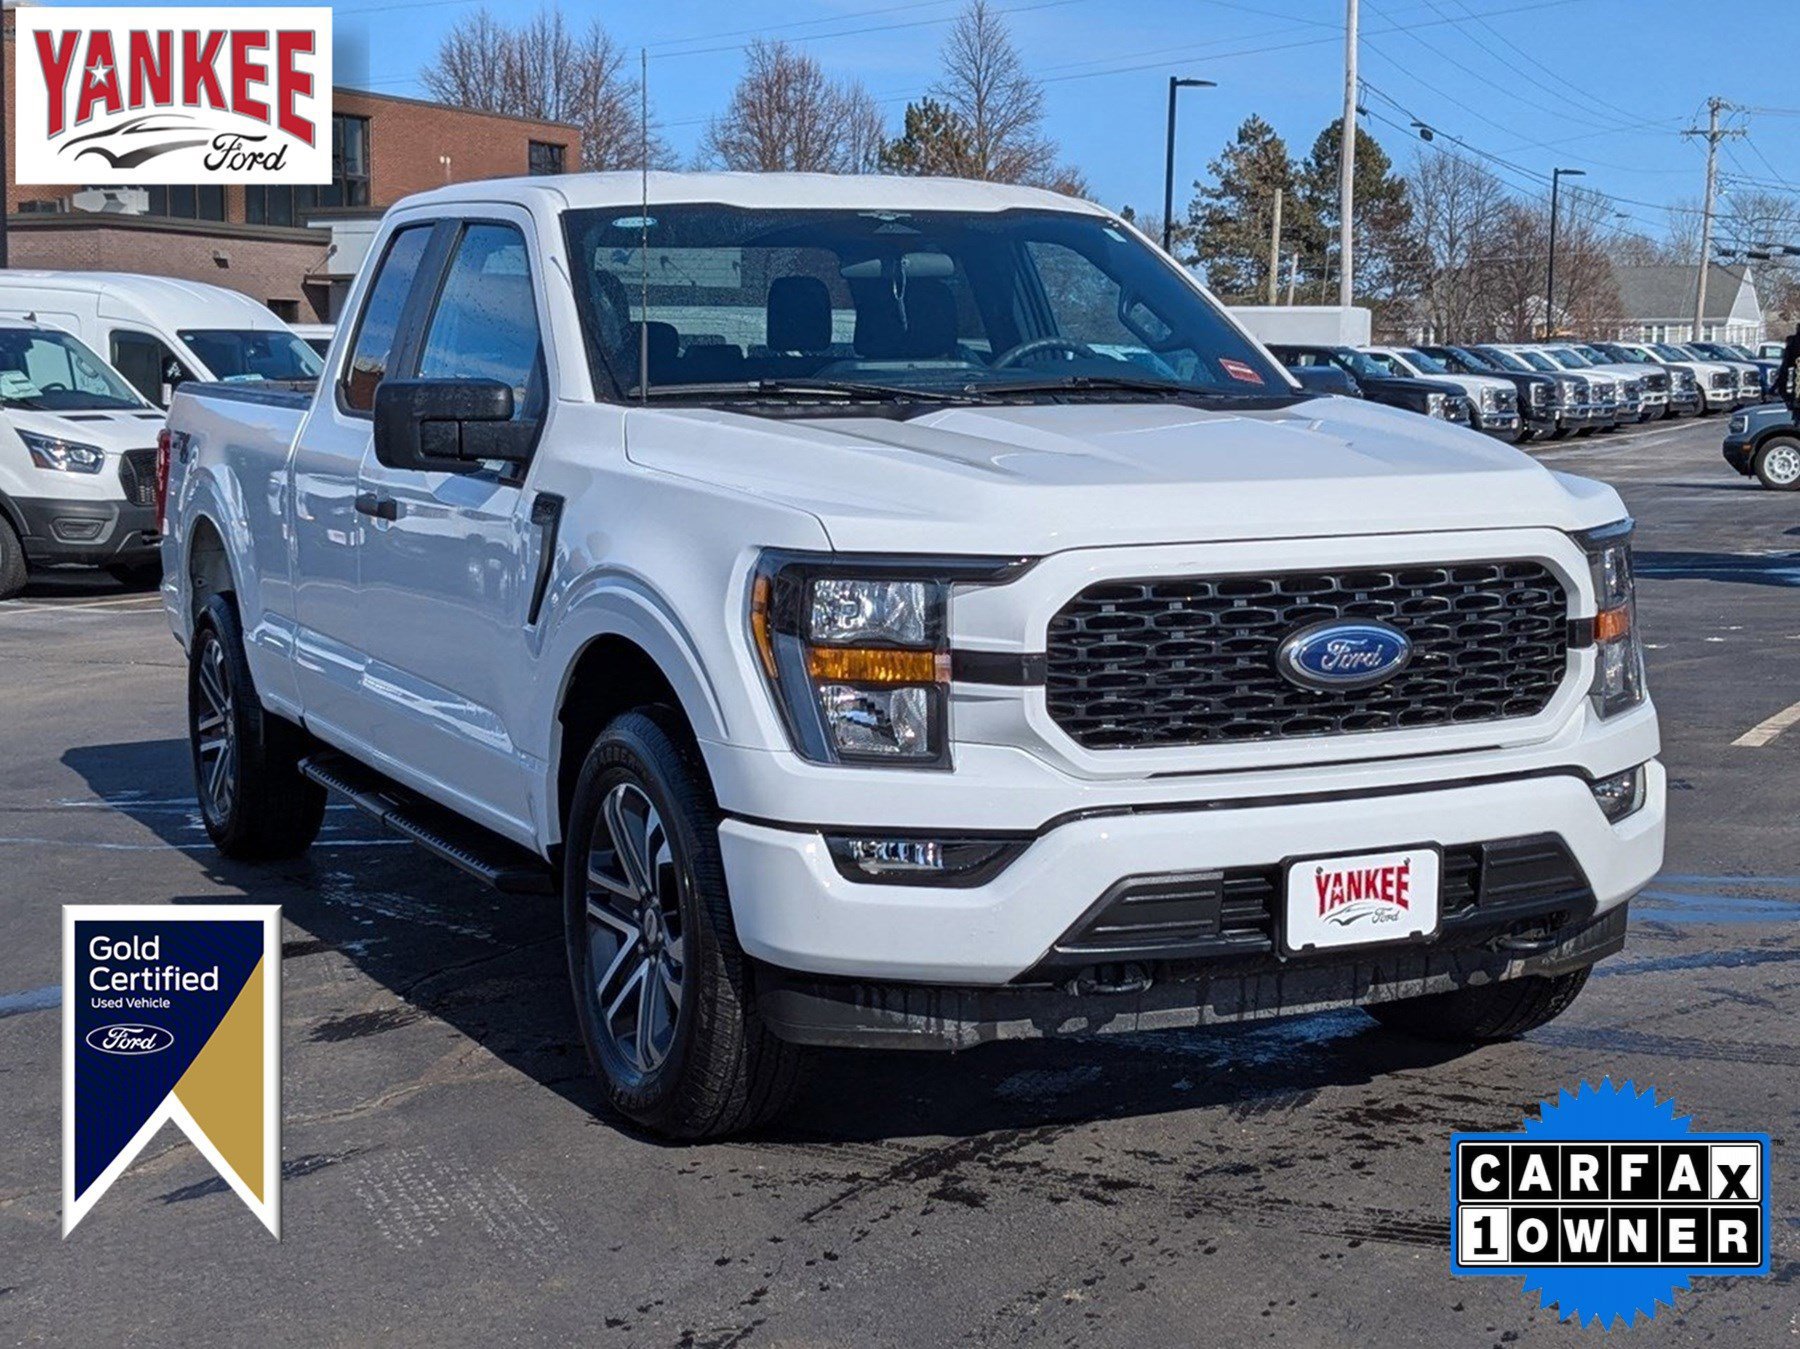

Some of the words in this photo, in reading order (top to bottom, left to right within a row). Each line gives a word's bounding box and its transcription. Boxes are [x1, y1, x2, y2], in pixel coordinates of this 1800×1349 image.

[1321, 638, 1383, 671] Ford
[1314, 864, 1410, 918] YANKEE
[1371, 907, 1400, 924] Ford
